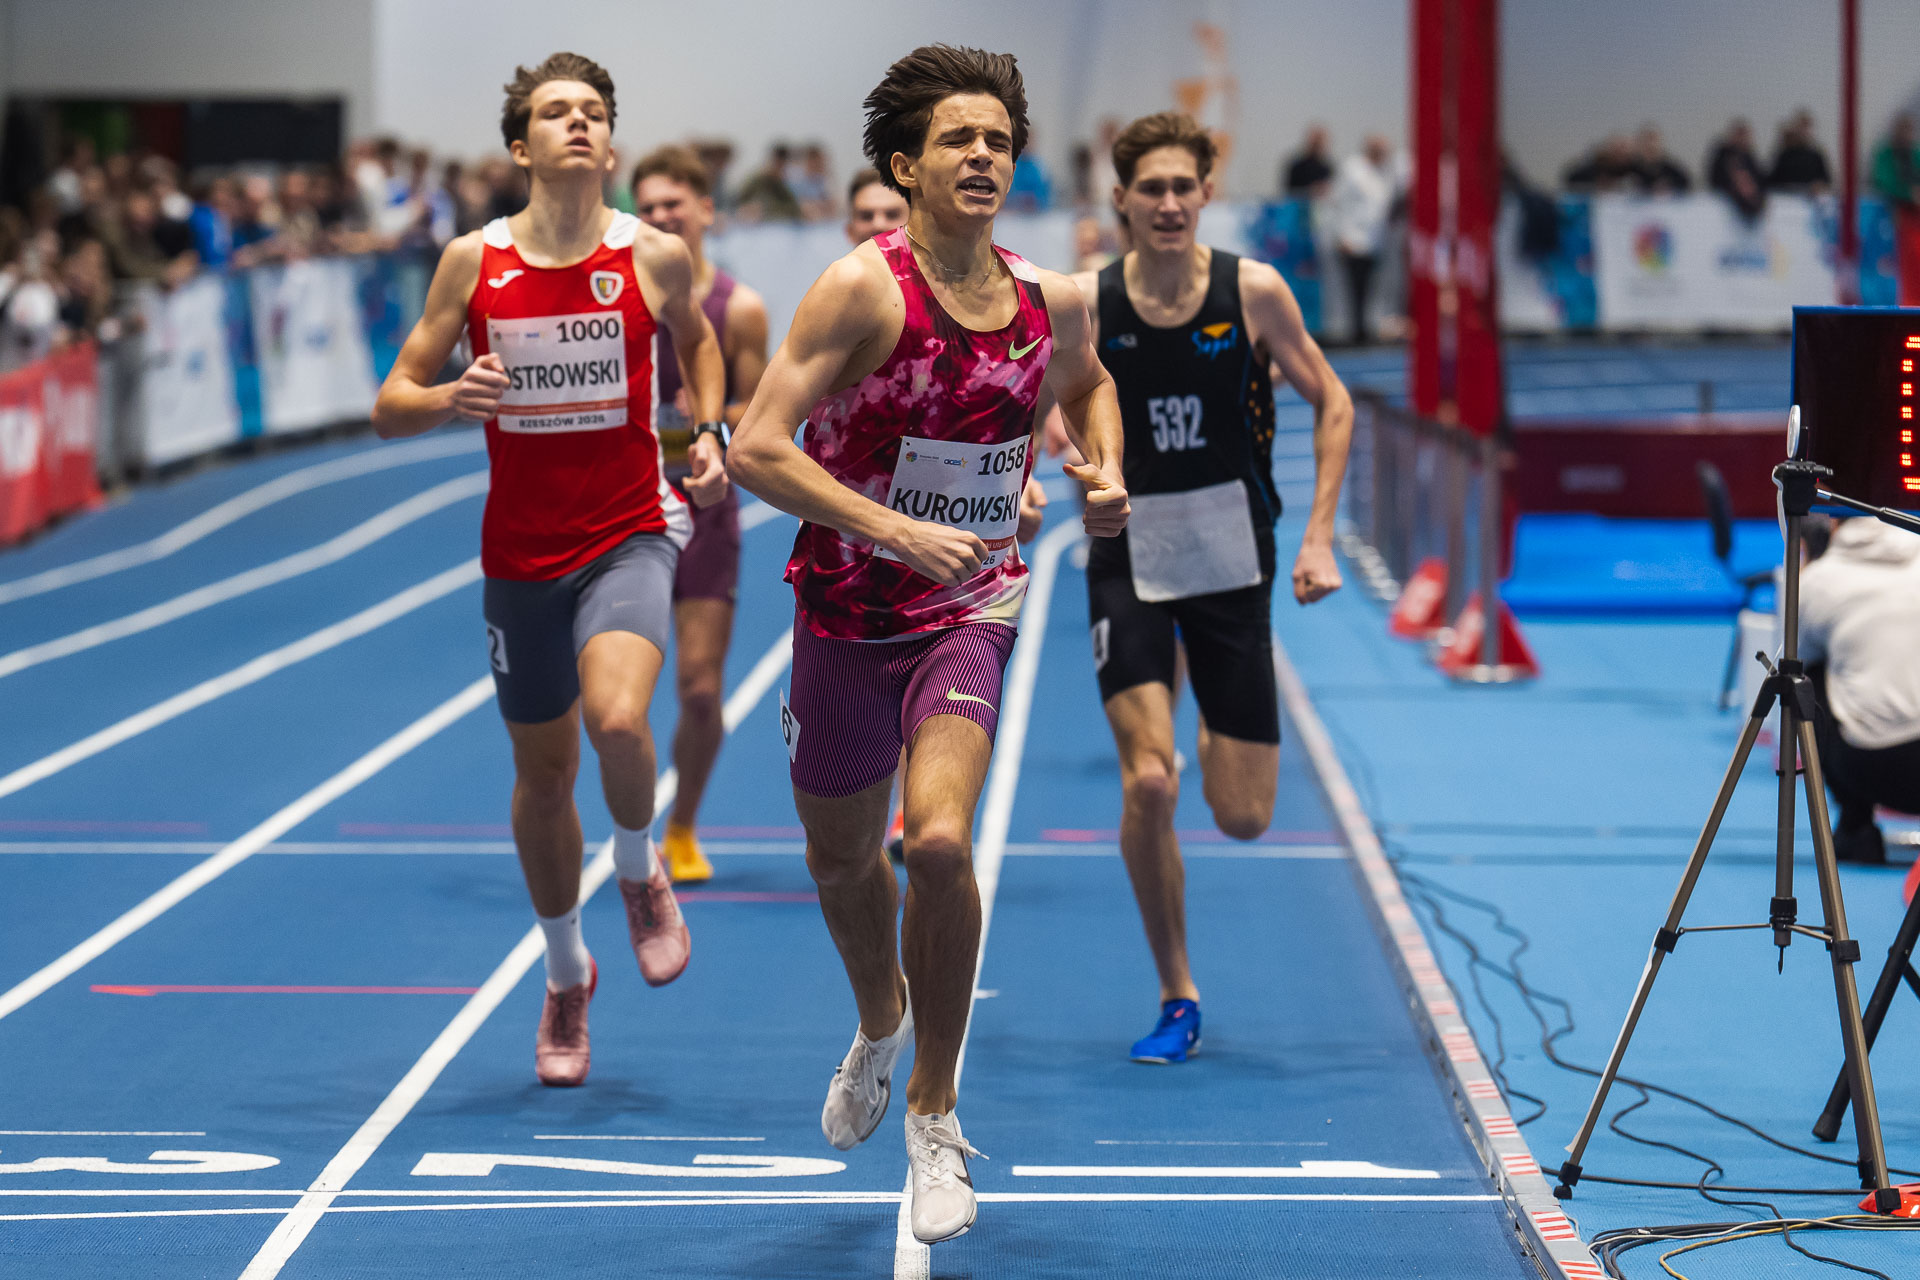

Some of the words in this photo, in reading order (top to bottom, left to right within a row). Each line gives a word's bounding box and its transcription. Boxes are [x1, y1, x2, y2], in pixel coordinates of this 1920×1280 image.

[557, 318, 619, 343] 1000
[519, 414, 574, 428] RZESZÓW
[578, 413, 605, 426] 2026
[1147, 394, 1207, 453] 532
[977, 444, 1025, 475] 1058
[892, 487, 1019, 524] KUROWSKI
[782, 704, 793, 746] 6
[409, 1151, 847, 1177] 2
[1012, 1160, 1441, 1179] 1
